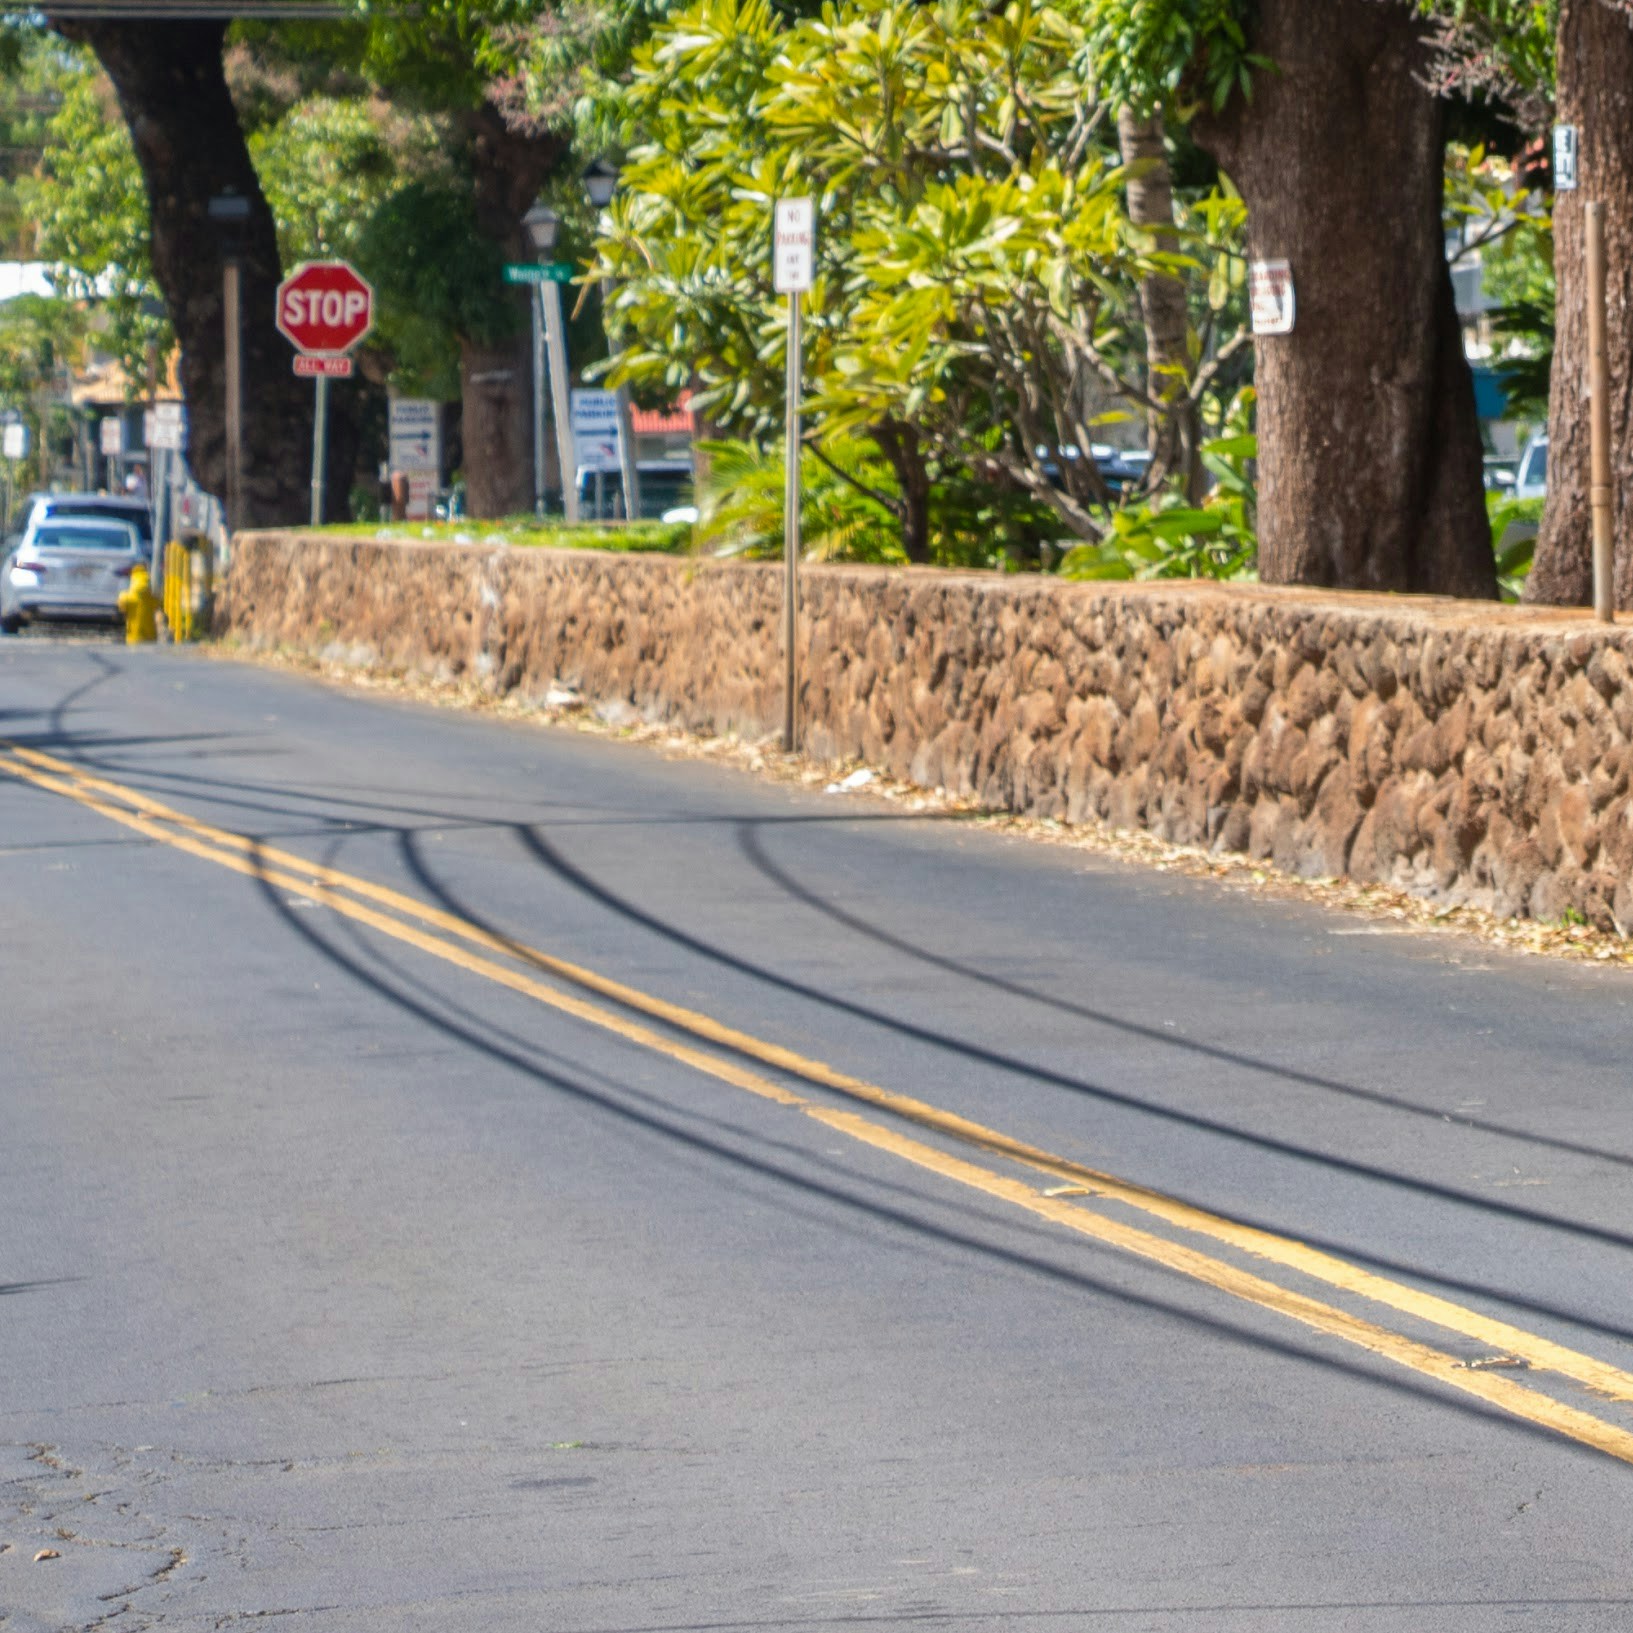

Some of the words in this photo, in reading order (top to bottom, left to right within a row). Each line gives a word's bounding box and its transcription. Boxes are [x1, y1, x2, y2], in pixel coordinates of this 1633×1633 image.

[787, 209, 801, 224] NO
[777, 232, 809, 246] PARKING
[284, 289, 365, 327] STOP
